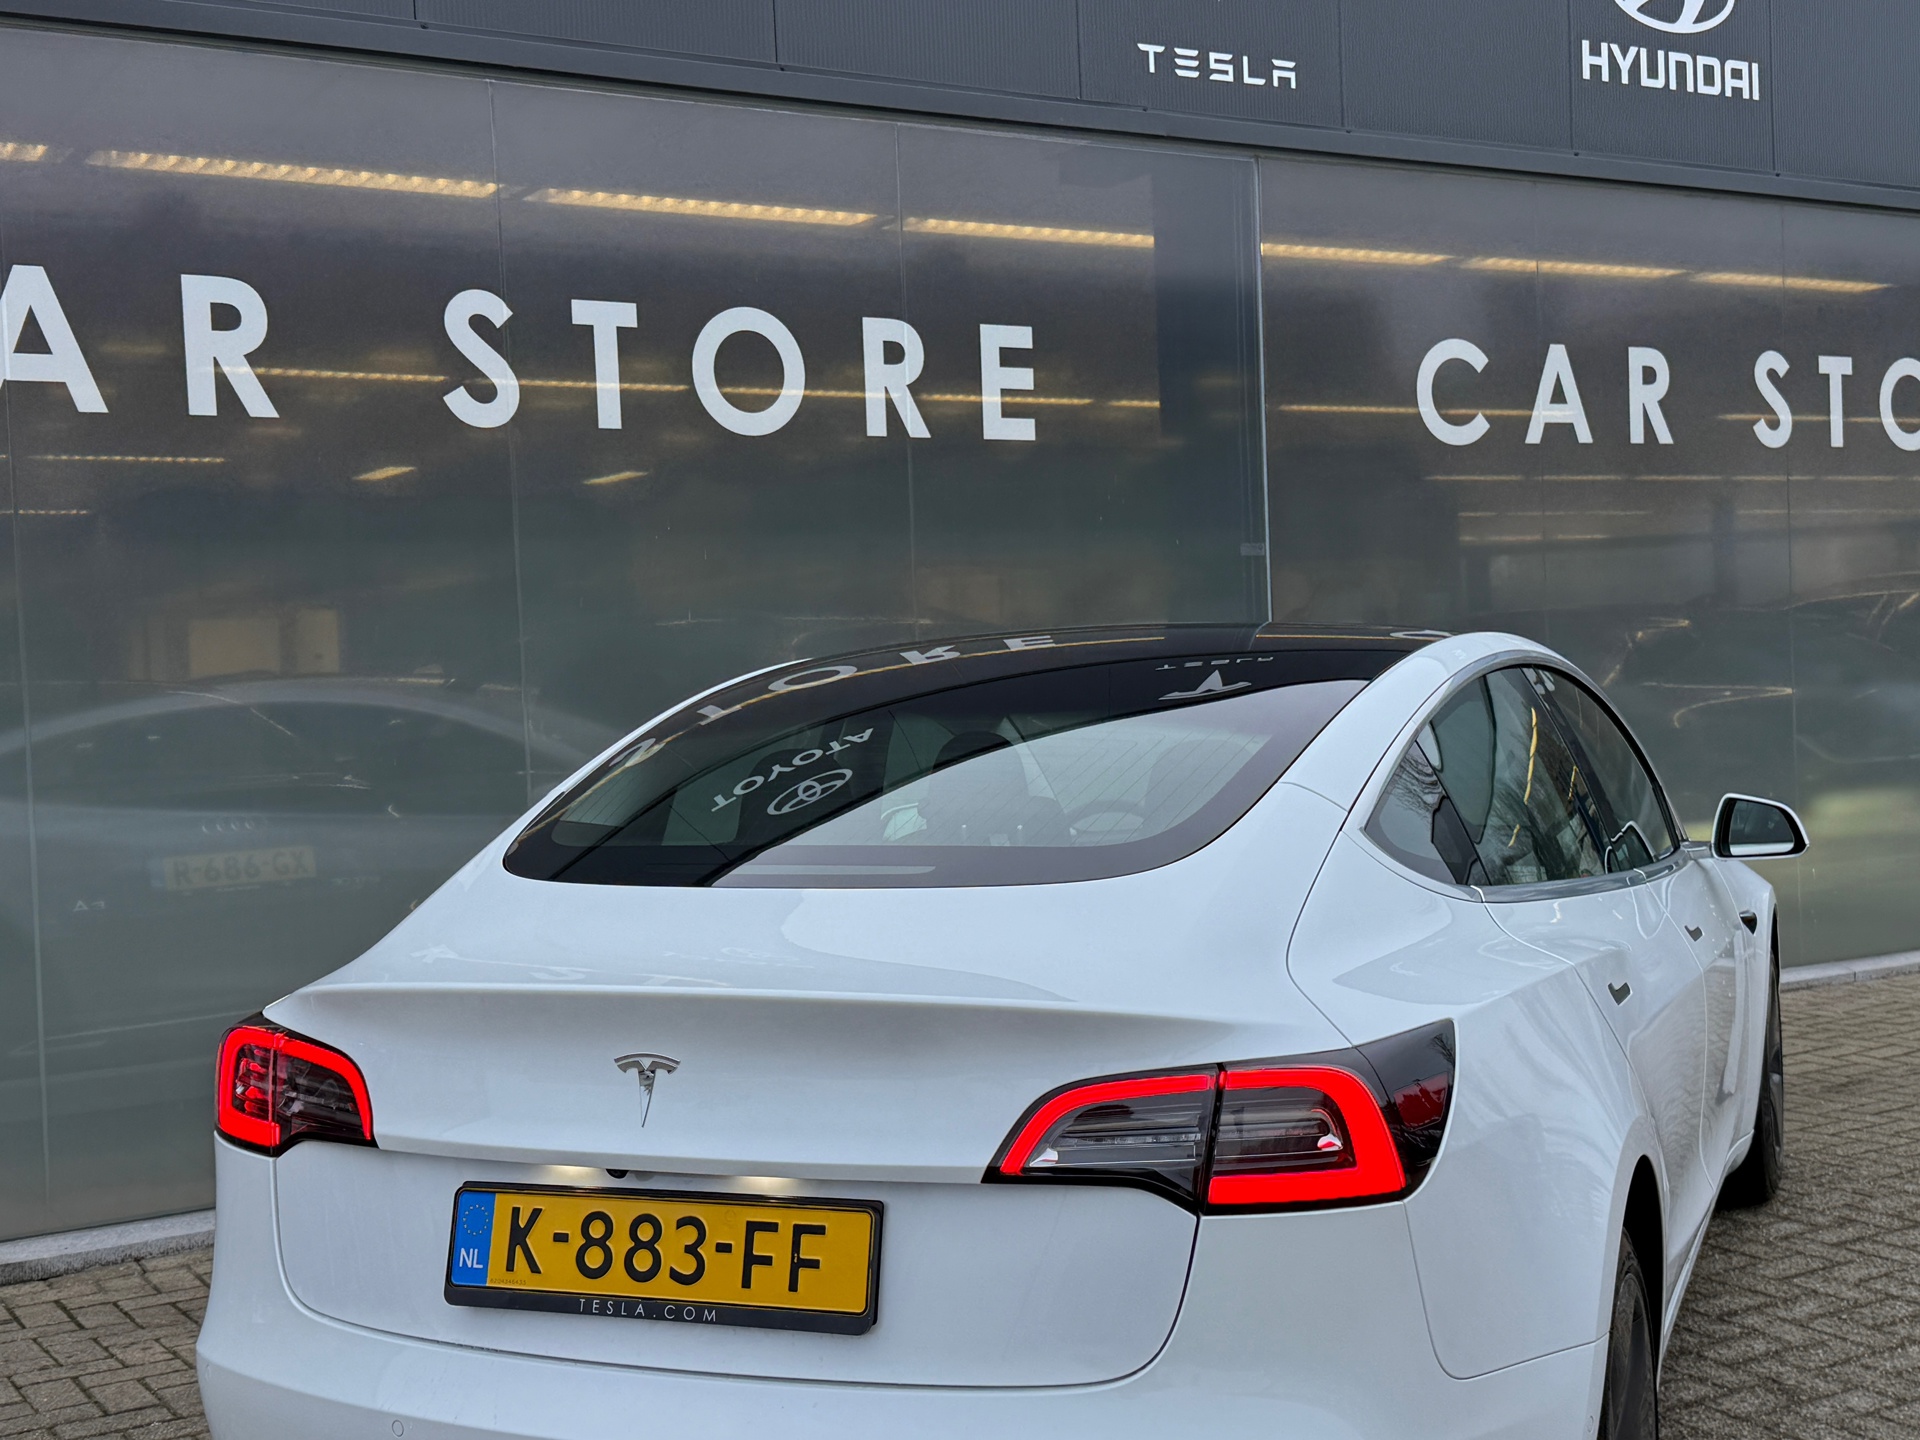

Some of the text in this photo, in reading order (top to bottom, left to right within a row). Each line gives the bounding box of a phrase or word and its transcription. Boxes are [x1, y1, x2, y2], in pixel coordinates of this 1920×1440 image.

[1137, 43, 1296, 89] TESLA
[1582, 40, 1759, 100] HYUNDAI
[0, 264, 1036, 441] AR STORE
[1416, 338, 1674, 447] CAR
[459, 1248, 483, 1269] NL
[505, 1206, 827, 1292] K-883-FF
[579, 1298, 716, 1322] TESLA.COM
